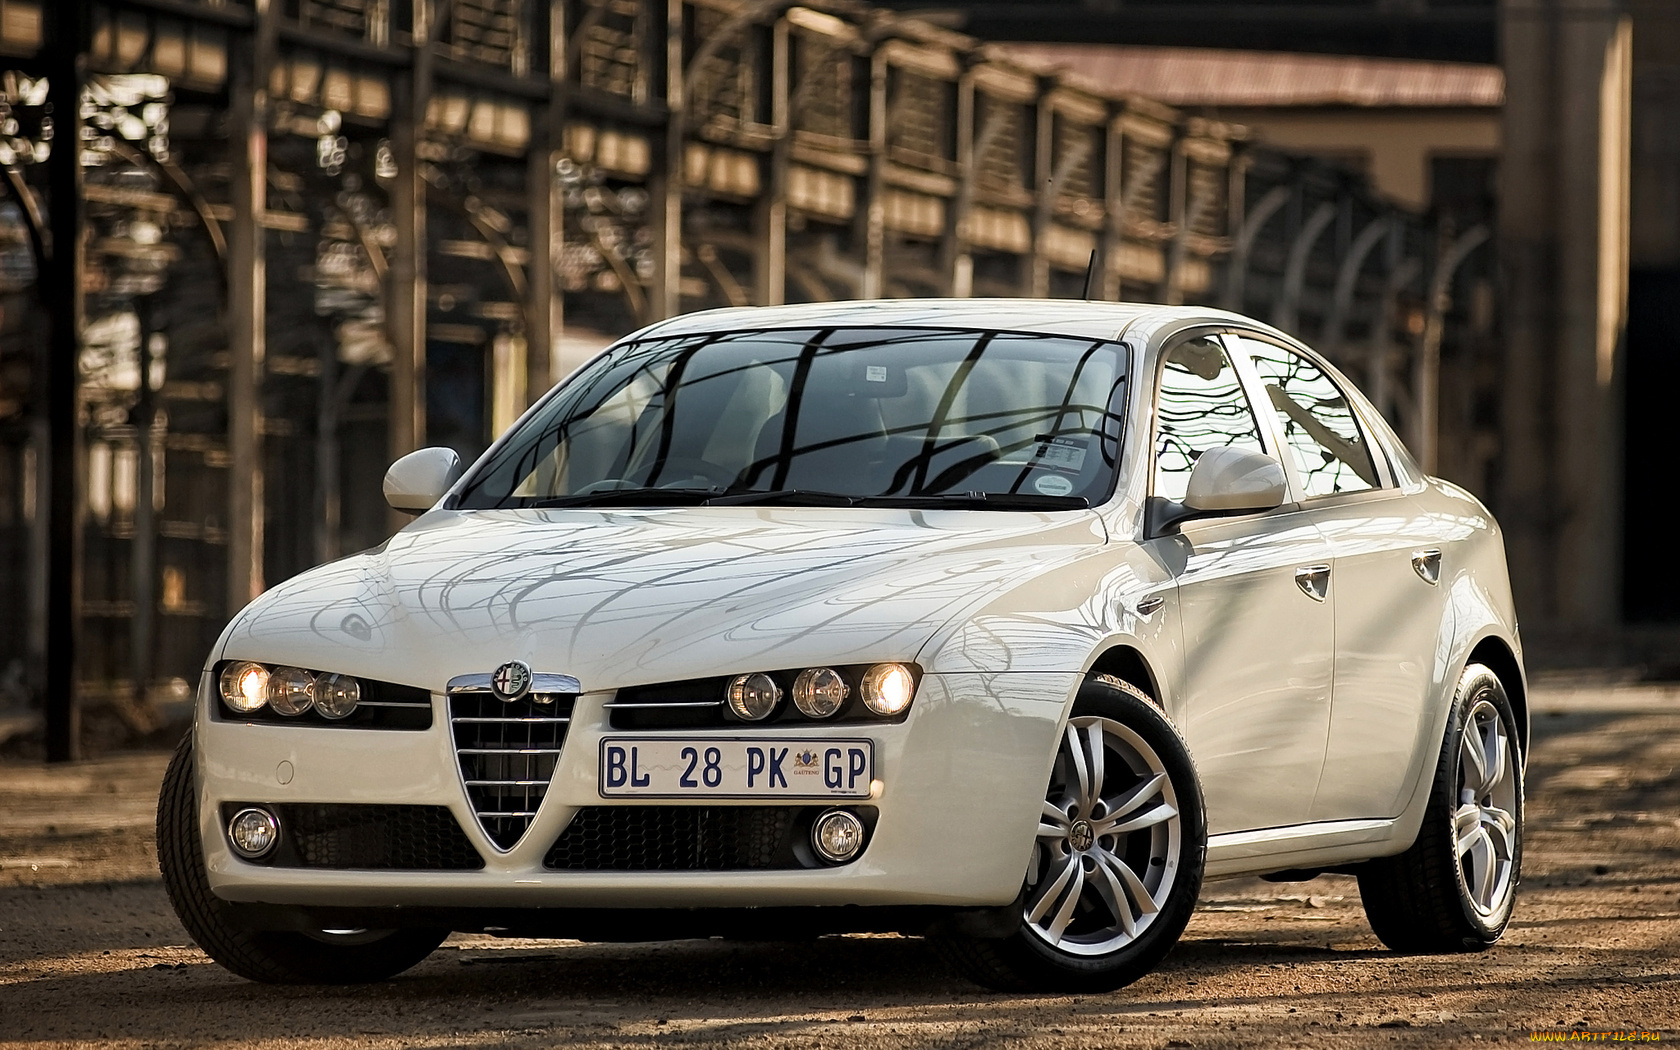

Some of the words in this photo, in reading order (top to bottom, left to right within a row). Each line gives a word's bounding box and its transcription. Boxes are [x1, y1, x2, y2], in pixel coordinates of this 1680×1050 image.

[606, 746, 651, 788] BL
[679, 746, 723, 788] 28
[746, 747, 790, 789] PK
[824, 748, 867, 789] GP
